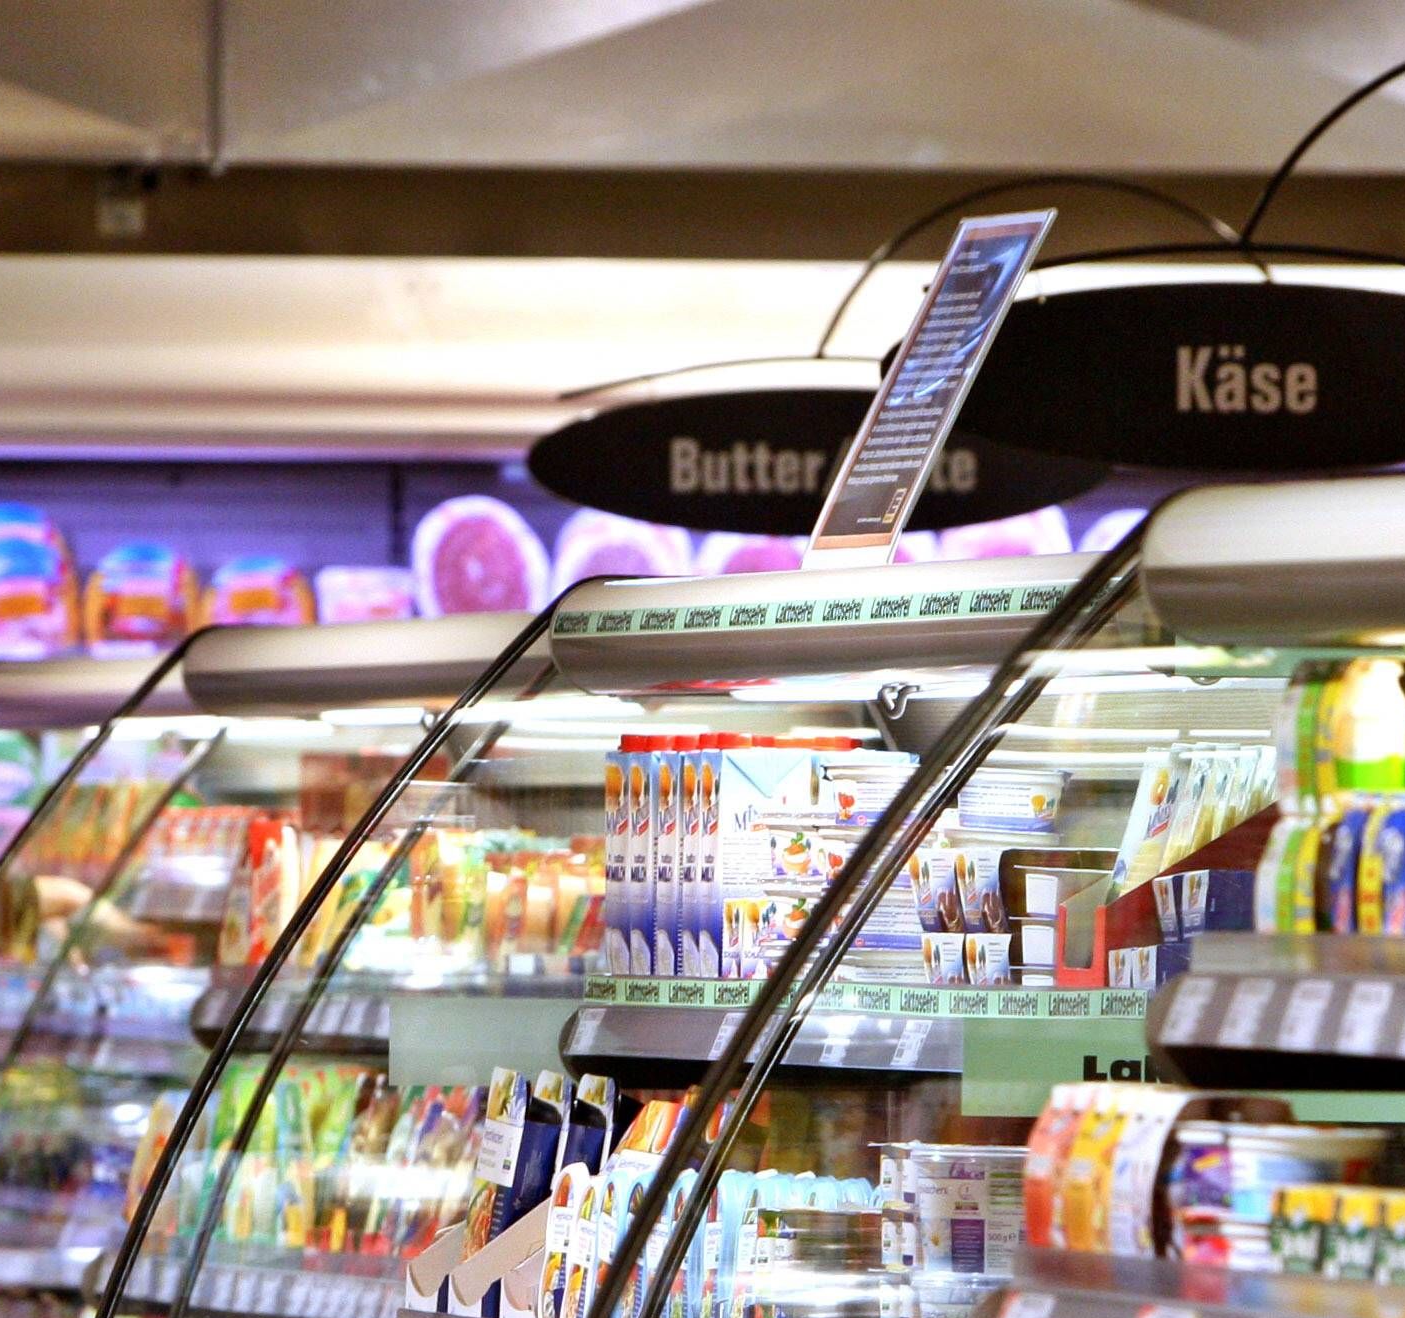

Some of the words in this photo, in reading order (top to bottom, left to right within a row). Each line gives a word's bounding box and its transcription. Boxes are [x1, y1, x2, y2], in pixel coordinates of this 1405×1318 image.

[1176, 344, 1318, 414] Käse
[950, 990, 988, 1014] Laktosefrei
[998, 991, 1038, 1016] Laktosefrei
